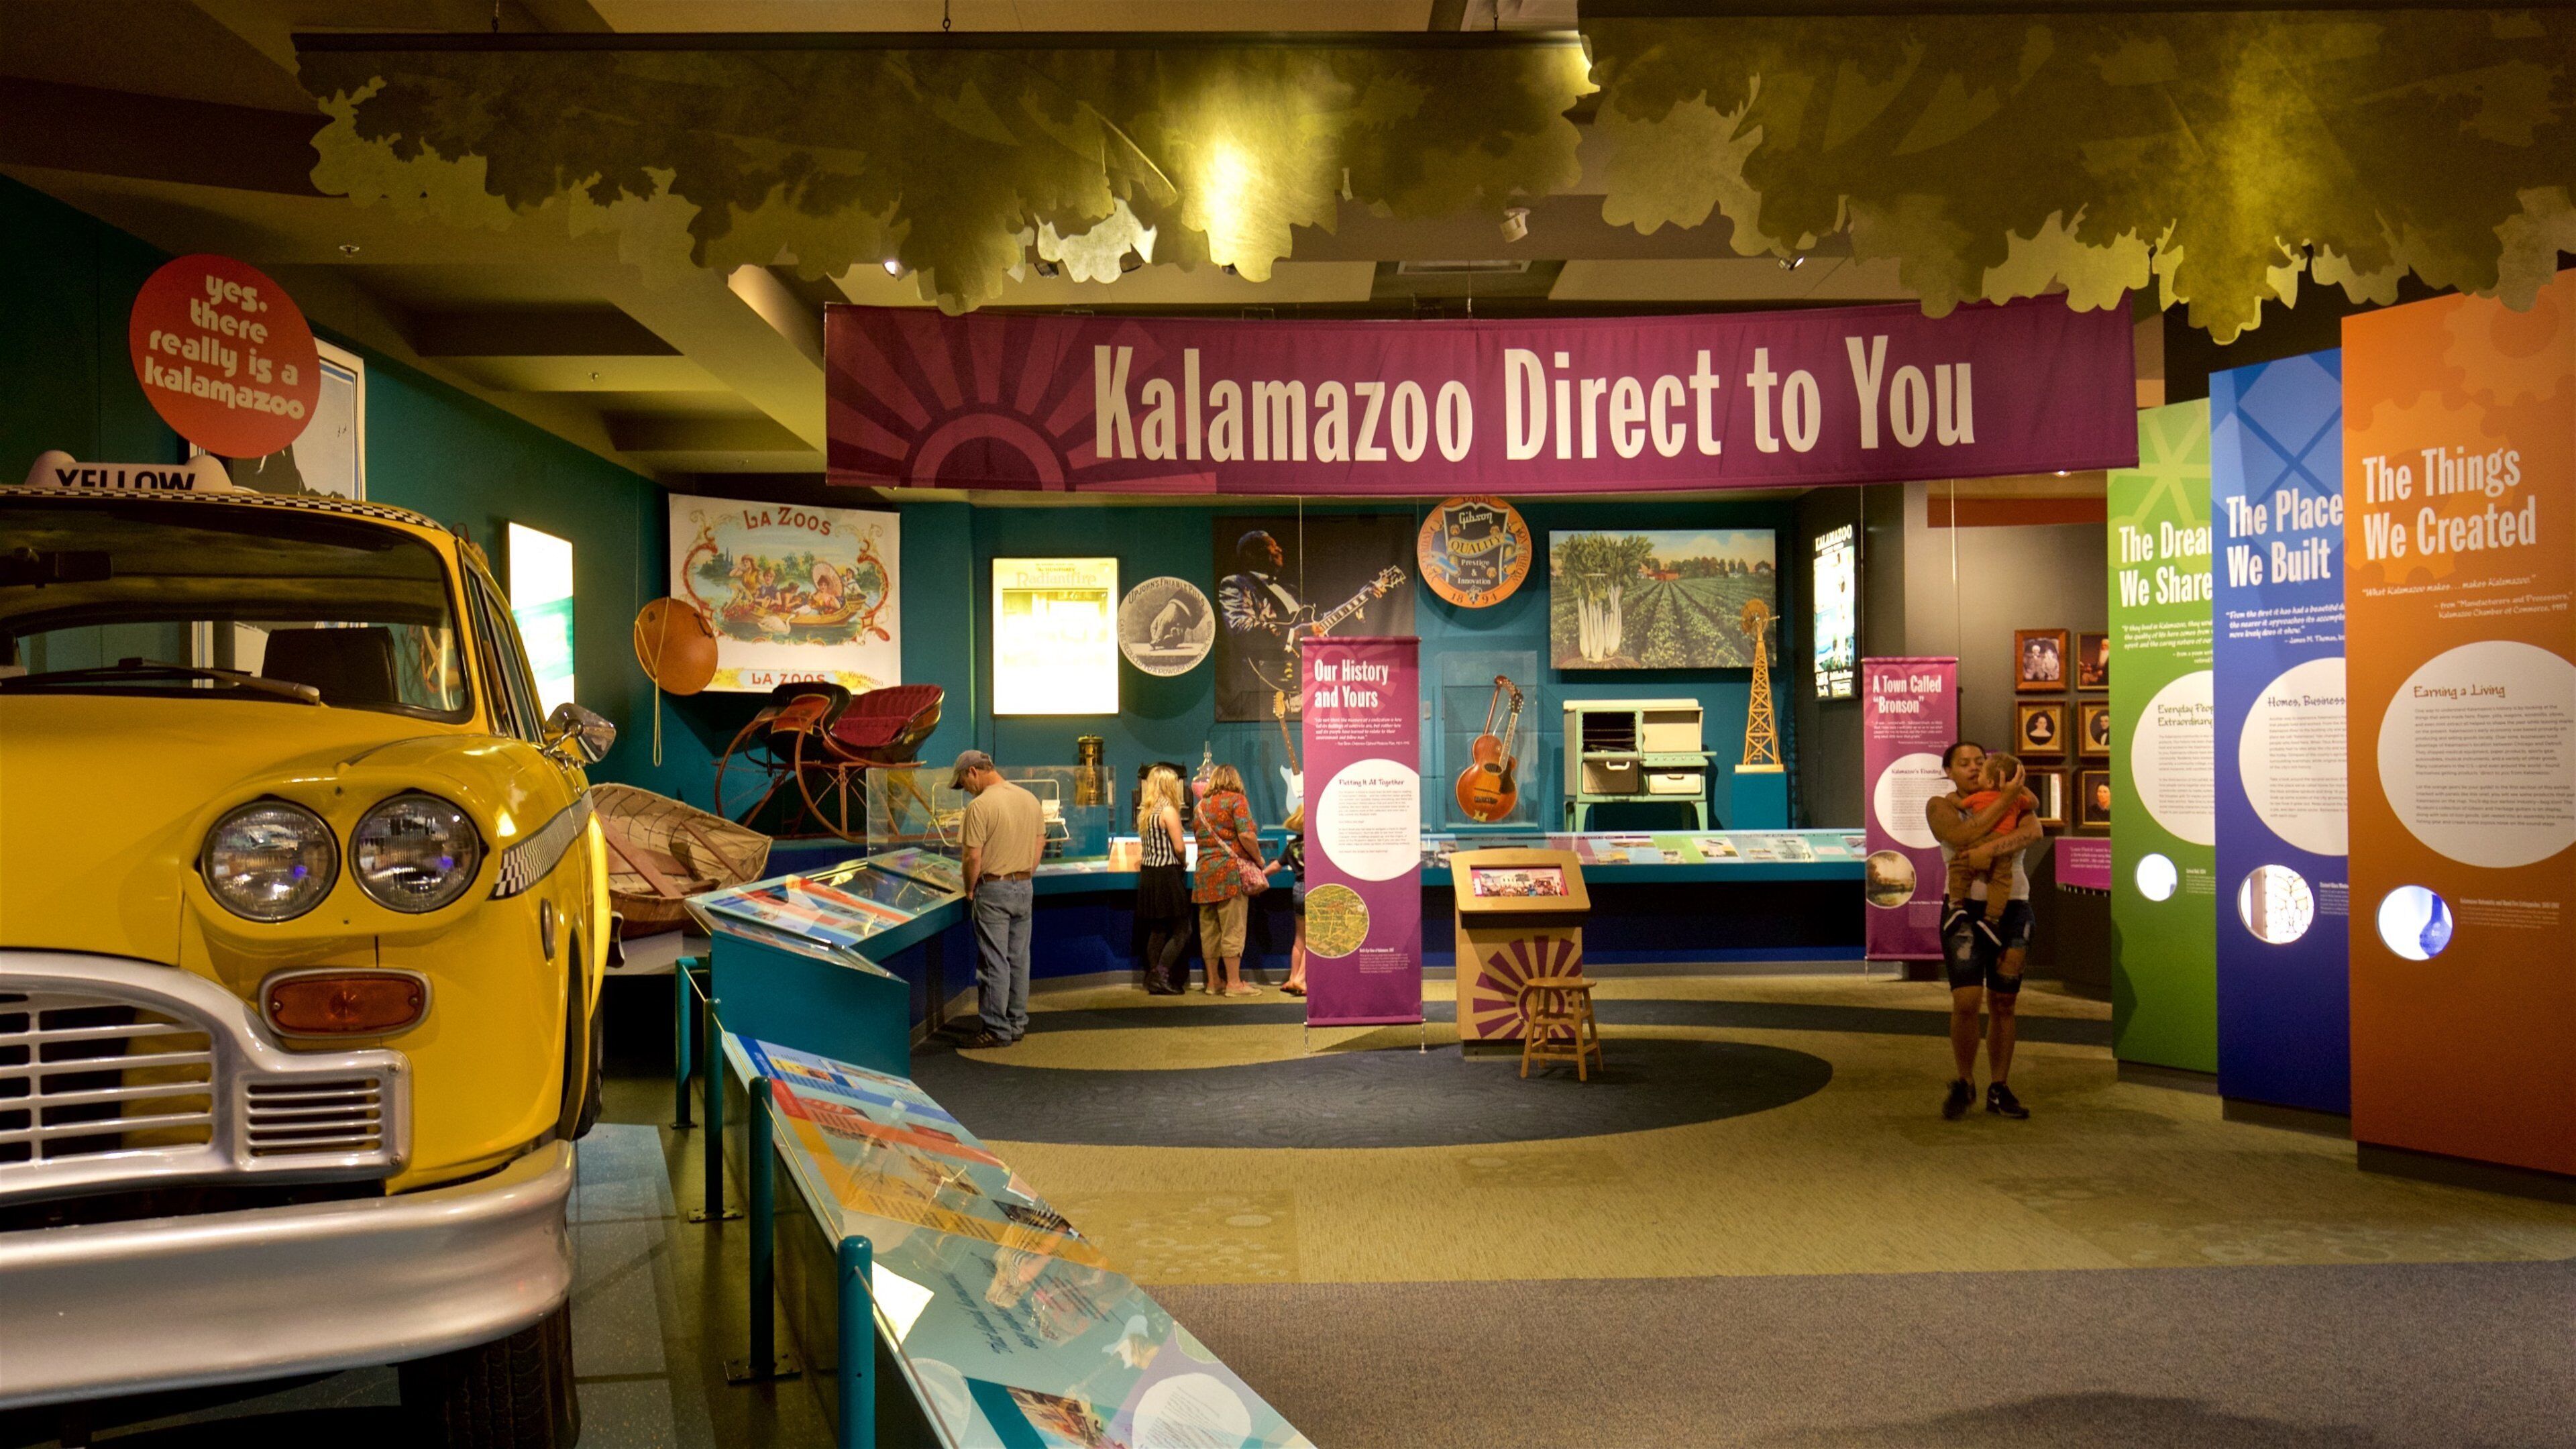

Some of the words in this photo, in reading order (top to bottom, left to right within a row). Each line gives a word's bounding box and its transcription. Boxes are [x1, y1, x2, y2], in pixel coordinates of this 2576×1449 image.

[190, 298, 268, 344] there
[150, 329, 237, 378] really
[248, 348, 272, 384] is
[280, 364, 299, 386] a
[144, 356, 305, 420] kalamazoo
[1095, 345, 1472, 462] Kalamazoo
[1505, 349, 1723, 460] Direct
[1746, 347, 1821, 453] to
[1847, 335, 1974, 448] You
[55, 468, 195, 490] YELLOW
[2362, 455, 2412, 503] The
[2421, 445, 2521, 498] Things
[743, 510, 771, 530] LA
[778, 506, 832, 535] ZOOS
[1459, 511, 1493, 530] Gibson
[2226, 495, 2267, 538] The
[2275, 488, 2344, 532] Place
[2363, 512, 2406, 560] We
[2417, 495, 2536, 555] Created
[1451, 535, 1501, 555] QUALITY
[2118, 526, 2153, 563] The
[2160, 521, 2212, 559] Drea
[1461, 559, 1490, 570] Prestige
[1471, 569, 1477, 577] &
[2227, 545, 2263, 588] We
[2271, 537, 2331, 584] Built
[1458, 577, 1491, 585] Innovation
[2119, 570, 2150, 608] We
[752, 673, 772, 685] LA
[1314, 659, 1338, 682] Our
[1342, 659, 1389, 686] History
[1872, 675, 1880, 693] A
[1882, 675, 1907, 693] Town
[1910, 674, 1942, 694] Called
[2414, 685, 2457, 700] Earning
[2470, 684, 2506, 698] Living
[1314, 686, 1339, 708] and
[1342, 686, 1379, 708] Yours
[2267, 696, 2301, 708] Homes,
[2158, 704, 2193, 717] Everyday
[1339, 779, 1362, 787] Putting
[1379, 779, 1405, 788] Together
